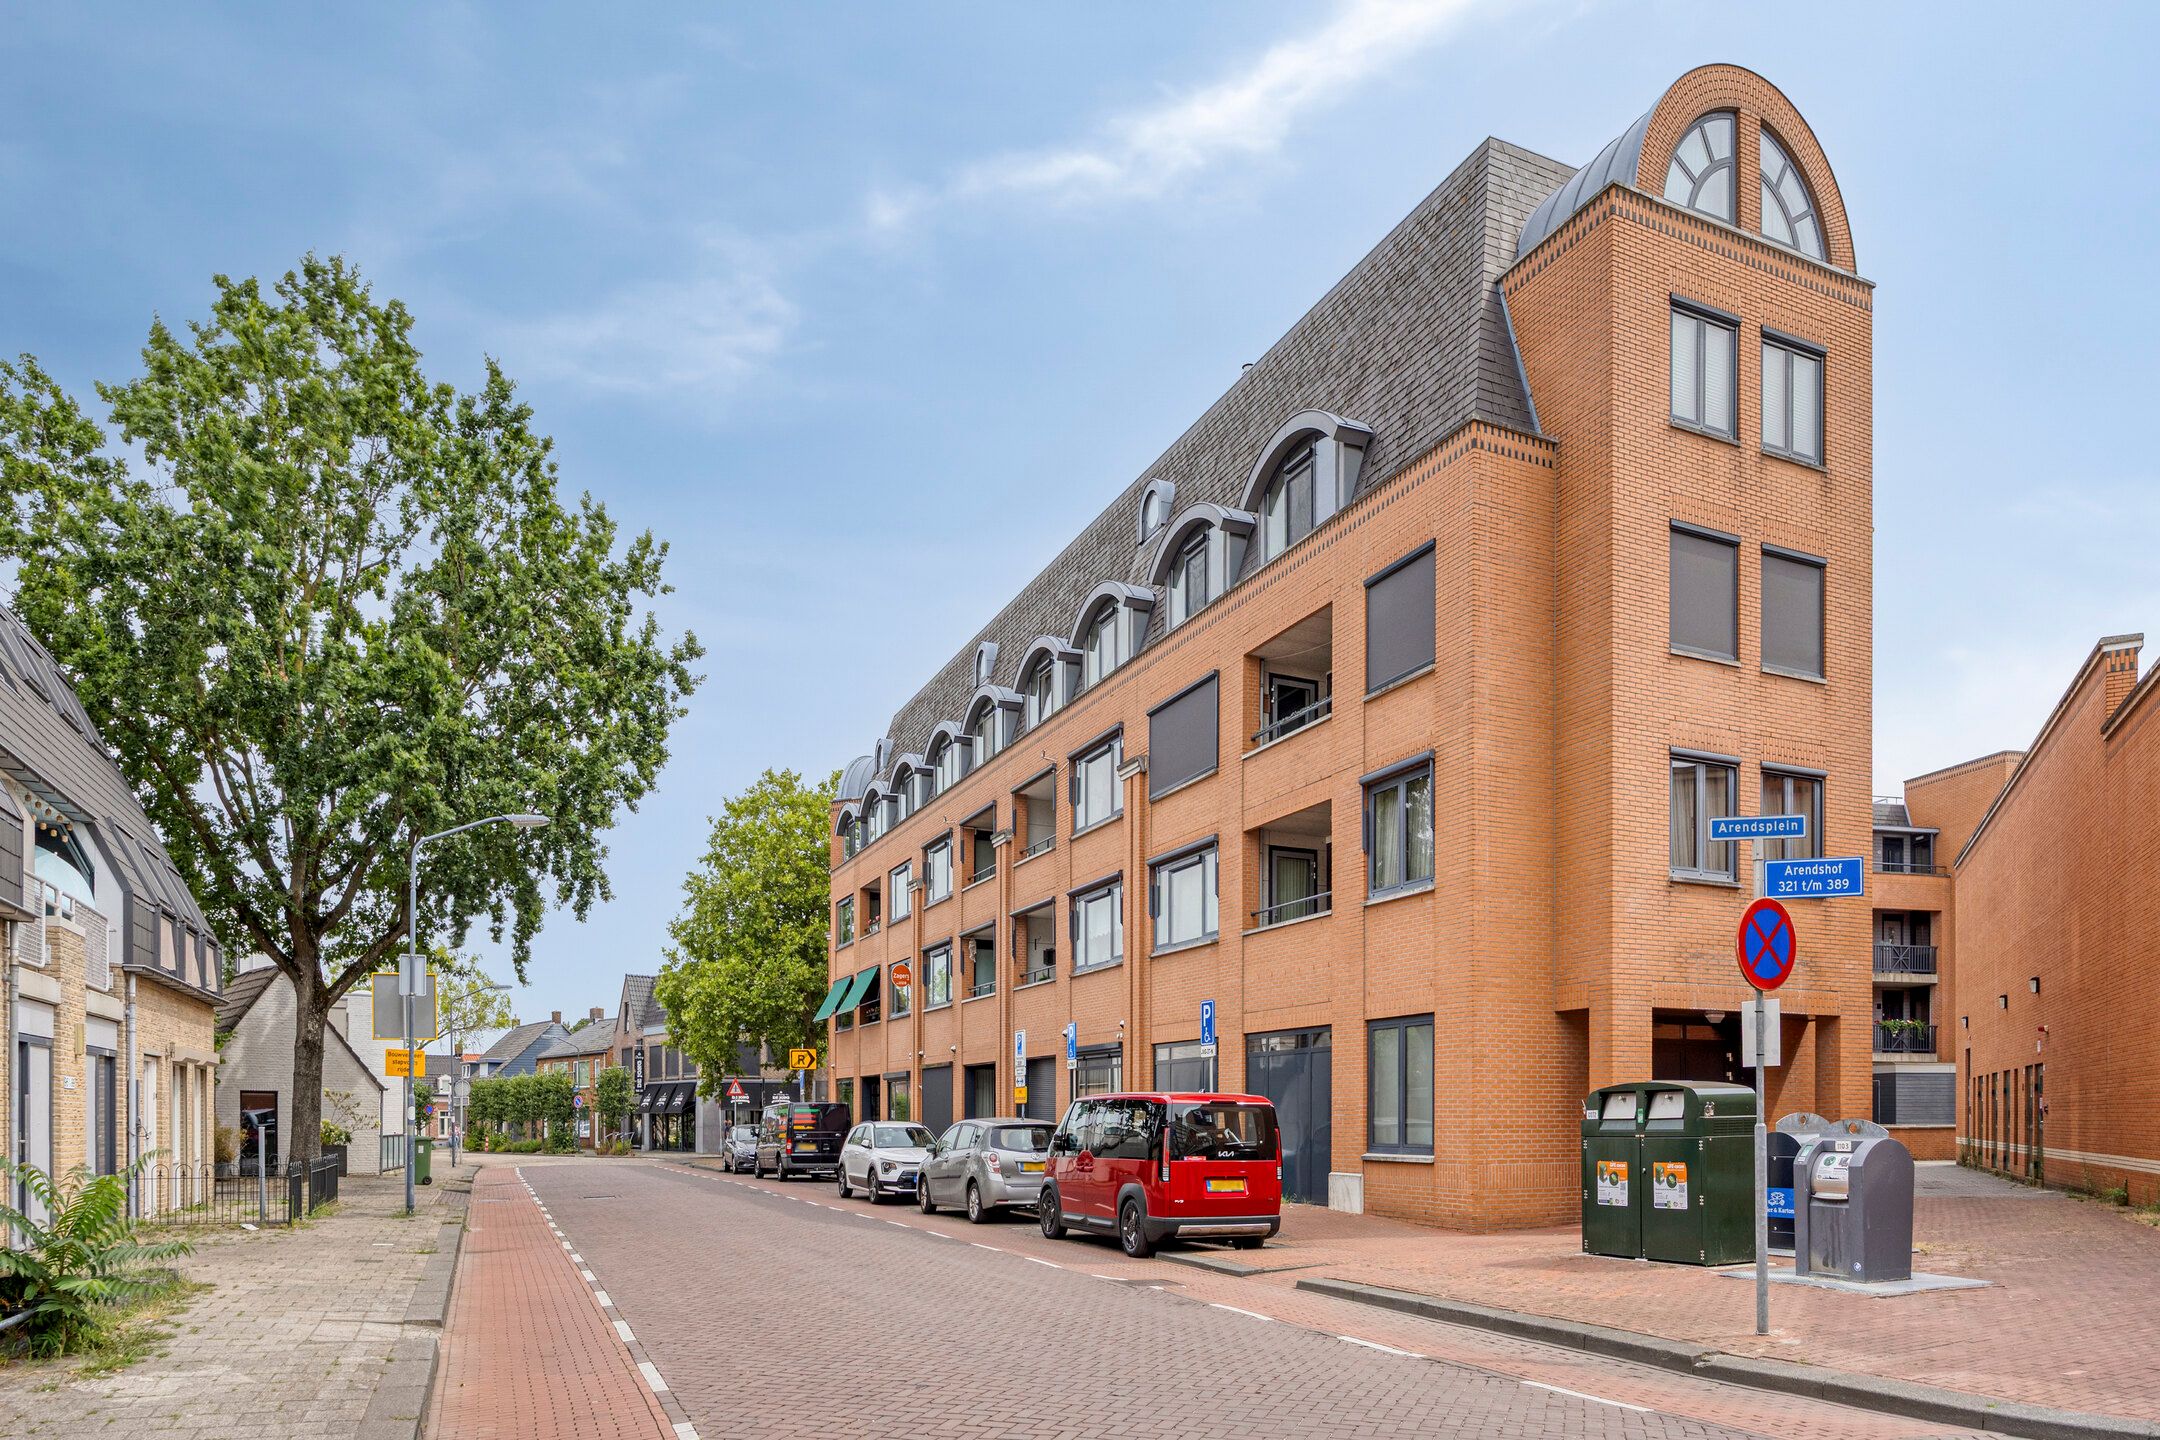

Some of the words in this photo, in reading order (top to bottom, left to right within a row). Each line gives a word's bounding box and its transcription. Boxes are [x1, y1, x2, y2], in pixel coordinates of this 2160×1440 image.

[1718, 820, 1798, 834] Arendsplein
[1784, 863, 1843, 876] Arendshof
[1778, 881, 1798, 892] 321
[1802, 879, 1822, 892] t/m
[1826, 878, 1849, 890] 389
[1203, 1005, 1211, 1027] P
[797, 1054, 805, 1065] R
[636, 1078, 643, 1088] DE
